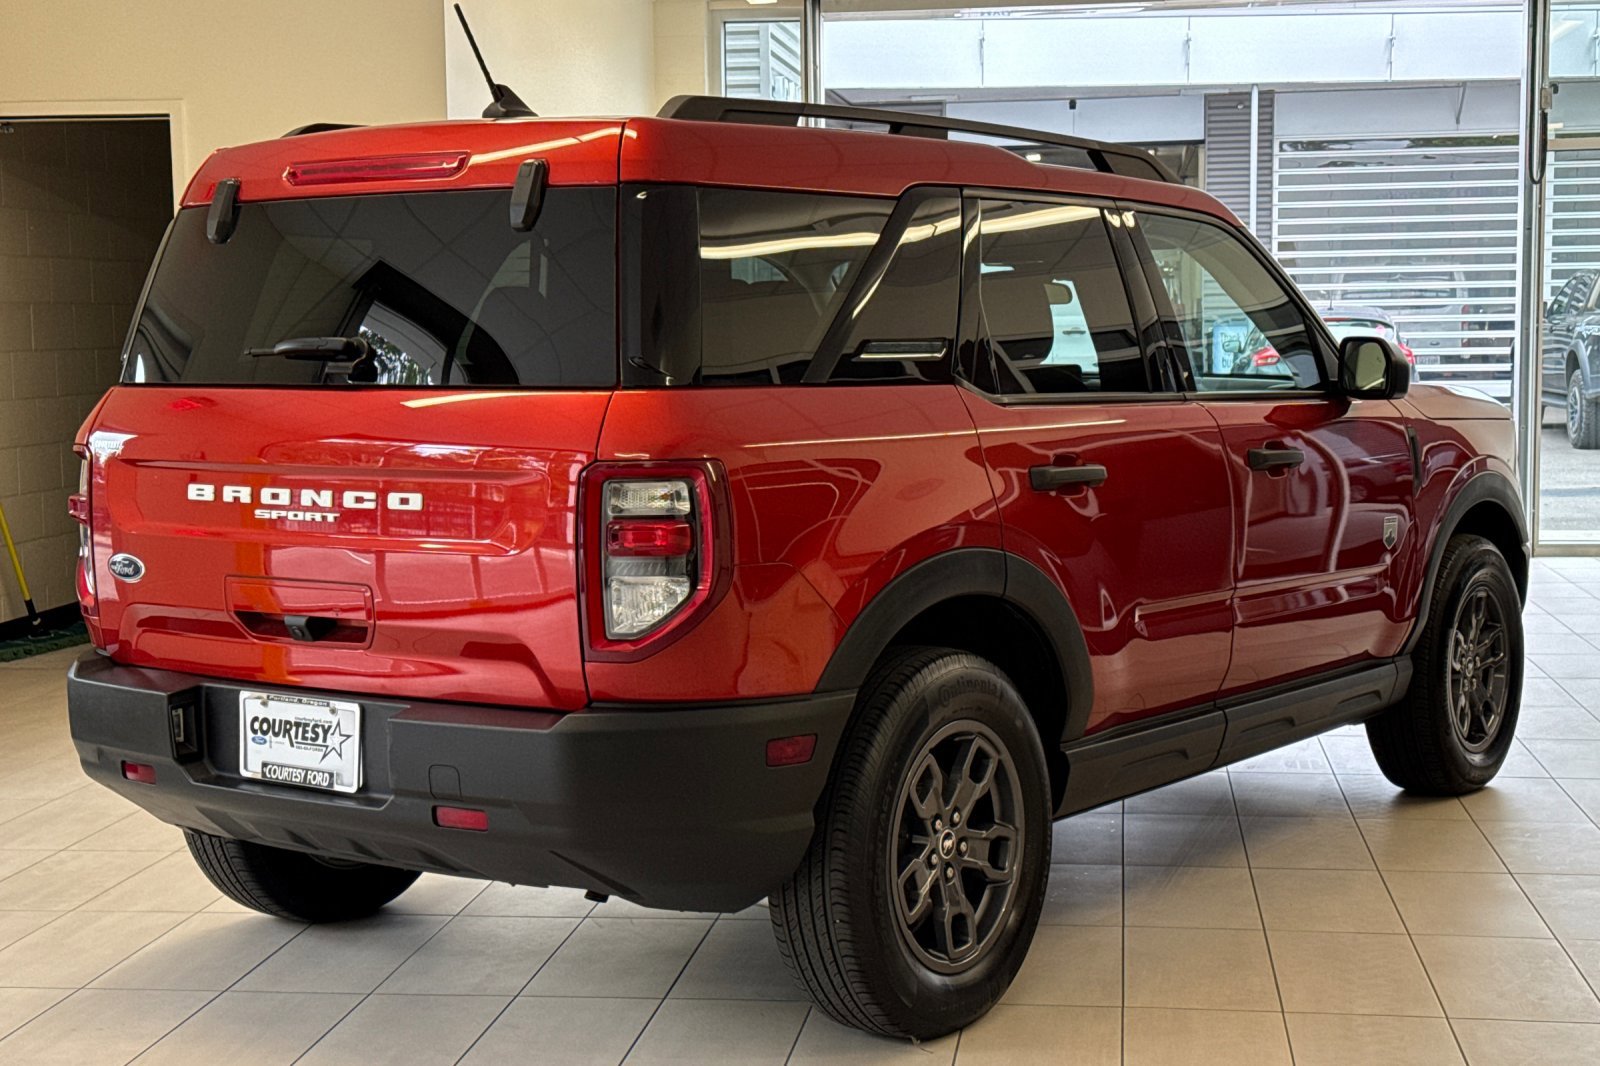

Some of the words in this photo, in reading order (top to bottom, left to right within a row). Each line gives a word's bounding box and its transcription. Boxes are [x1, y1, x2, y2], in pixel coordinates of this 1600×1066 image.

[187, 483, 423, 511] BRONCO
[254, 509, 341, 522] SPORT
[250, 715, 333, 748] COURTESY
[266, 765, 307, 784] COURTESY
[307, 771, 330, 786] FORD
